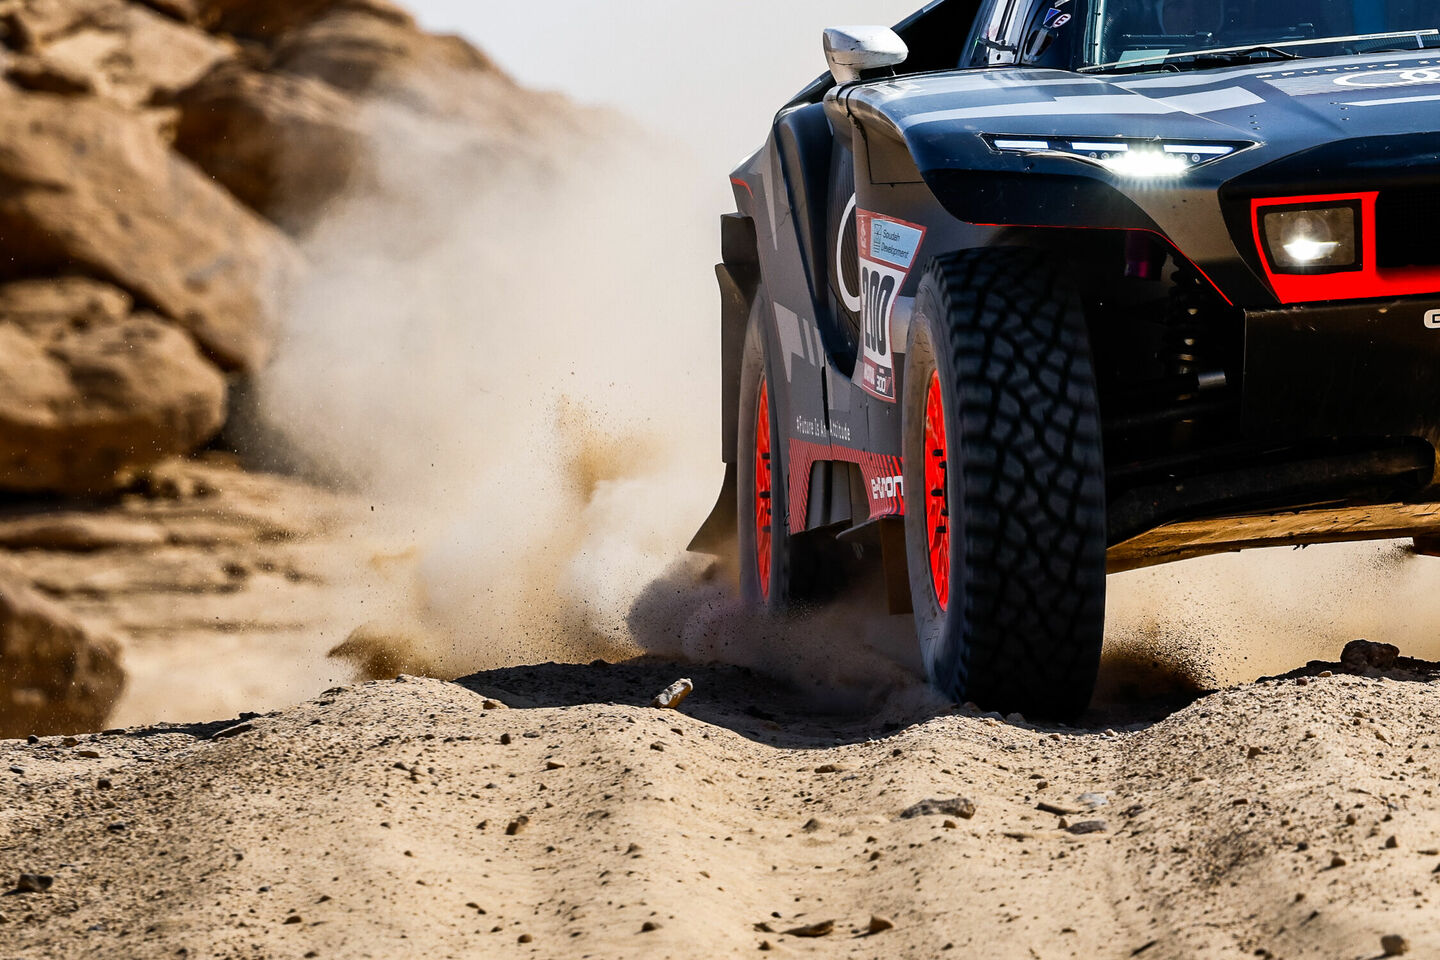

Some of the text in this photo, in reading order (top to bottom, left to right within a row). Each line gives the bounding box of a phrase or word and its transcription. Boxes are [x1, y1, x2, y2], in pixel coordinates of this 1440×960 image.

[882, 229, 901, 242] Soudah
[880, 242, 909, 259] Development
[861, 266, 895, 356] 200
[870, 475, 904, 500] e-tron
